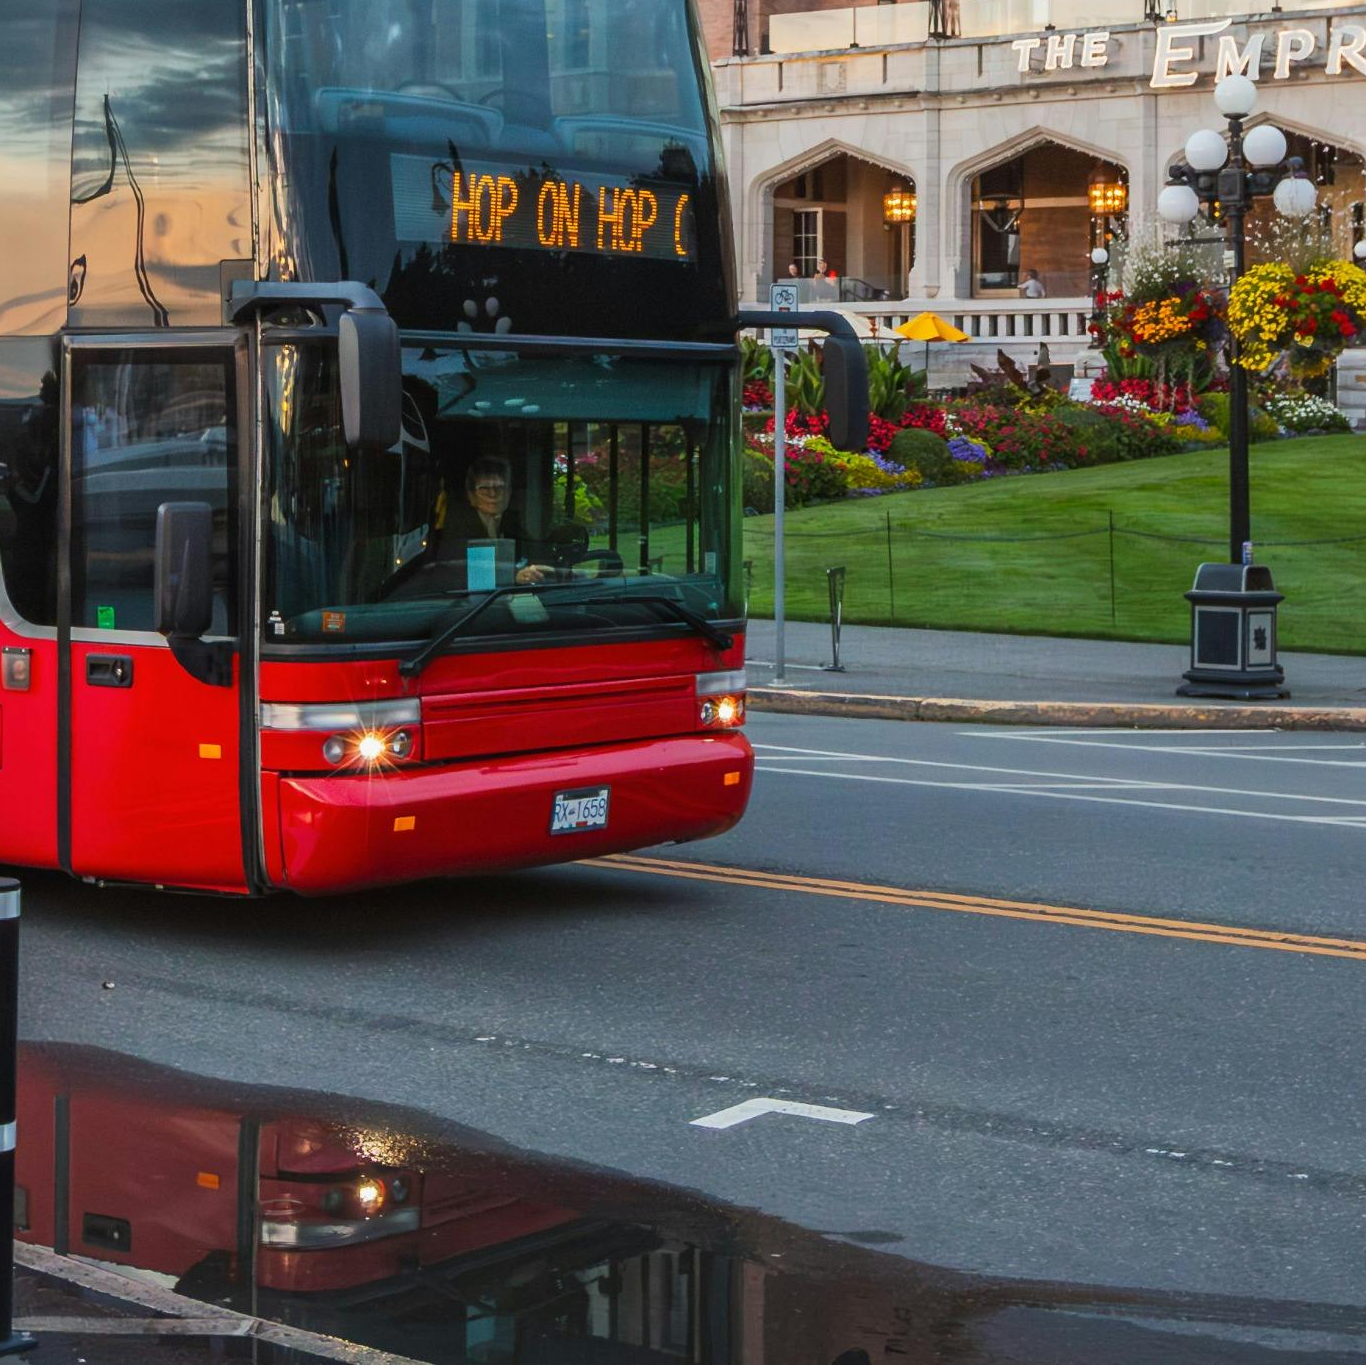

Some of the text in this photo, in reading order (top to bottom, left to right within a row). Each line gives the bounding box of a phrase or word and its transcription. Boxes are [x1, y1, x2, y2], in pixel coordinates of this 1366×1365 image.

[1012, 32, 1109, 72] THE
[451, 171, 518, 241] HOP
[537, 181, 580, 247] ON
[597, 187, 658, 252] HOP
